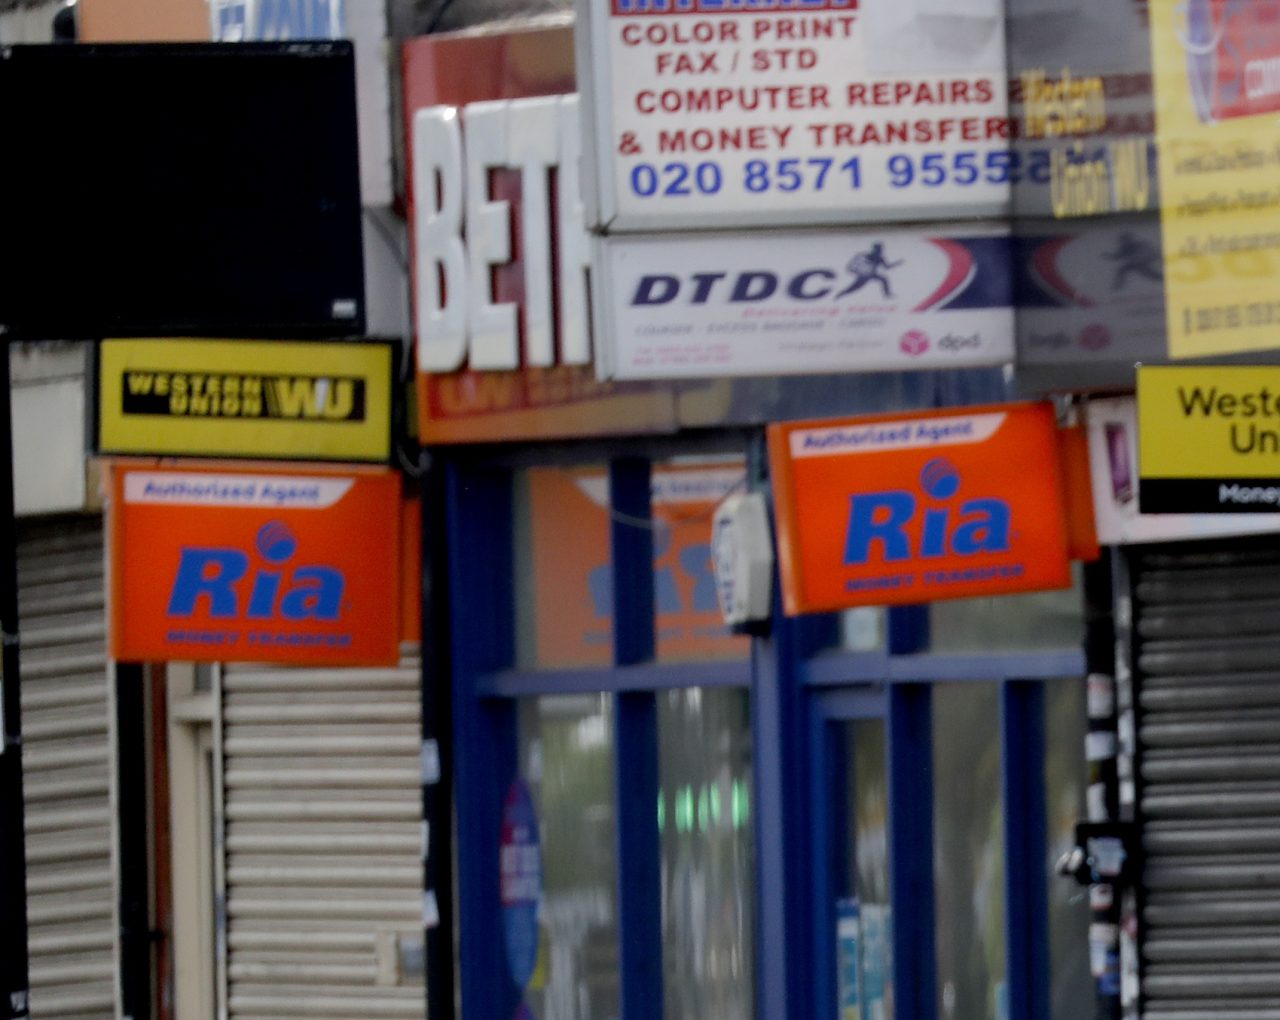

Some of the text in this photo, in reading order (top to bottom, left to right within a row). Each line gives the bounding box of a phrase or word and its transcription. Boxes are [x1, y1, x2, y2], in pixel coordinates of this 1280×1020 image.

[621, 16, 857, 46] COLOR PRINT
[655, 51, 719, 75] FAX
[751, 47, 819, 72] STD
[635, 79, 994, 114] COMPUTER REPAIRS
[618, 117, 1008, 155] & MONEY TRANSFER
[631, 150, 1010, 198] 020 8571 9555
[629, 268, 838, 306] DTDC
[128, 373, 262, 396] WESTERN
[169, 394, 262, 416] UNION
[803, 420, 974, 449] Authorized Agent
[143, 479, 321, 505] Authorized Agent
[842, 456, 1012, 566] Ria
[166, 519, 346, 622] Ria
[845, 564, 1025, 592] MONEY TRANSFER
[166, 630, 353, 648] MONEY TRANSFER
